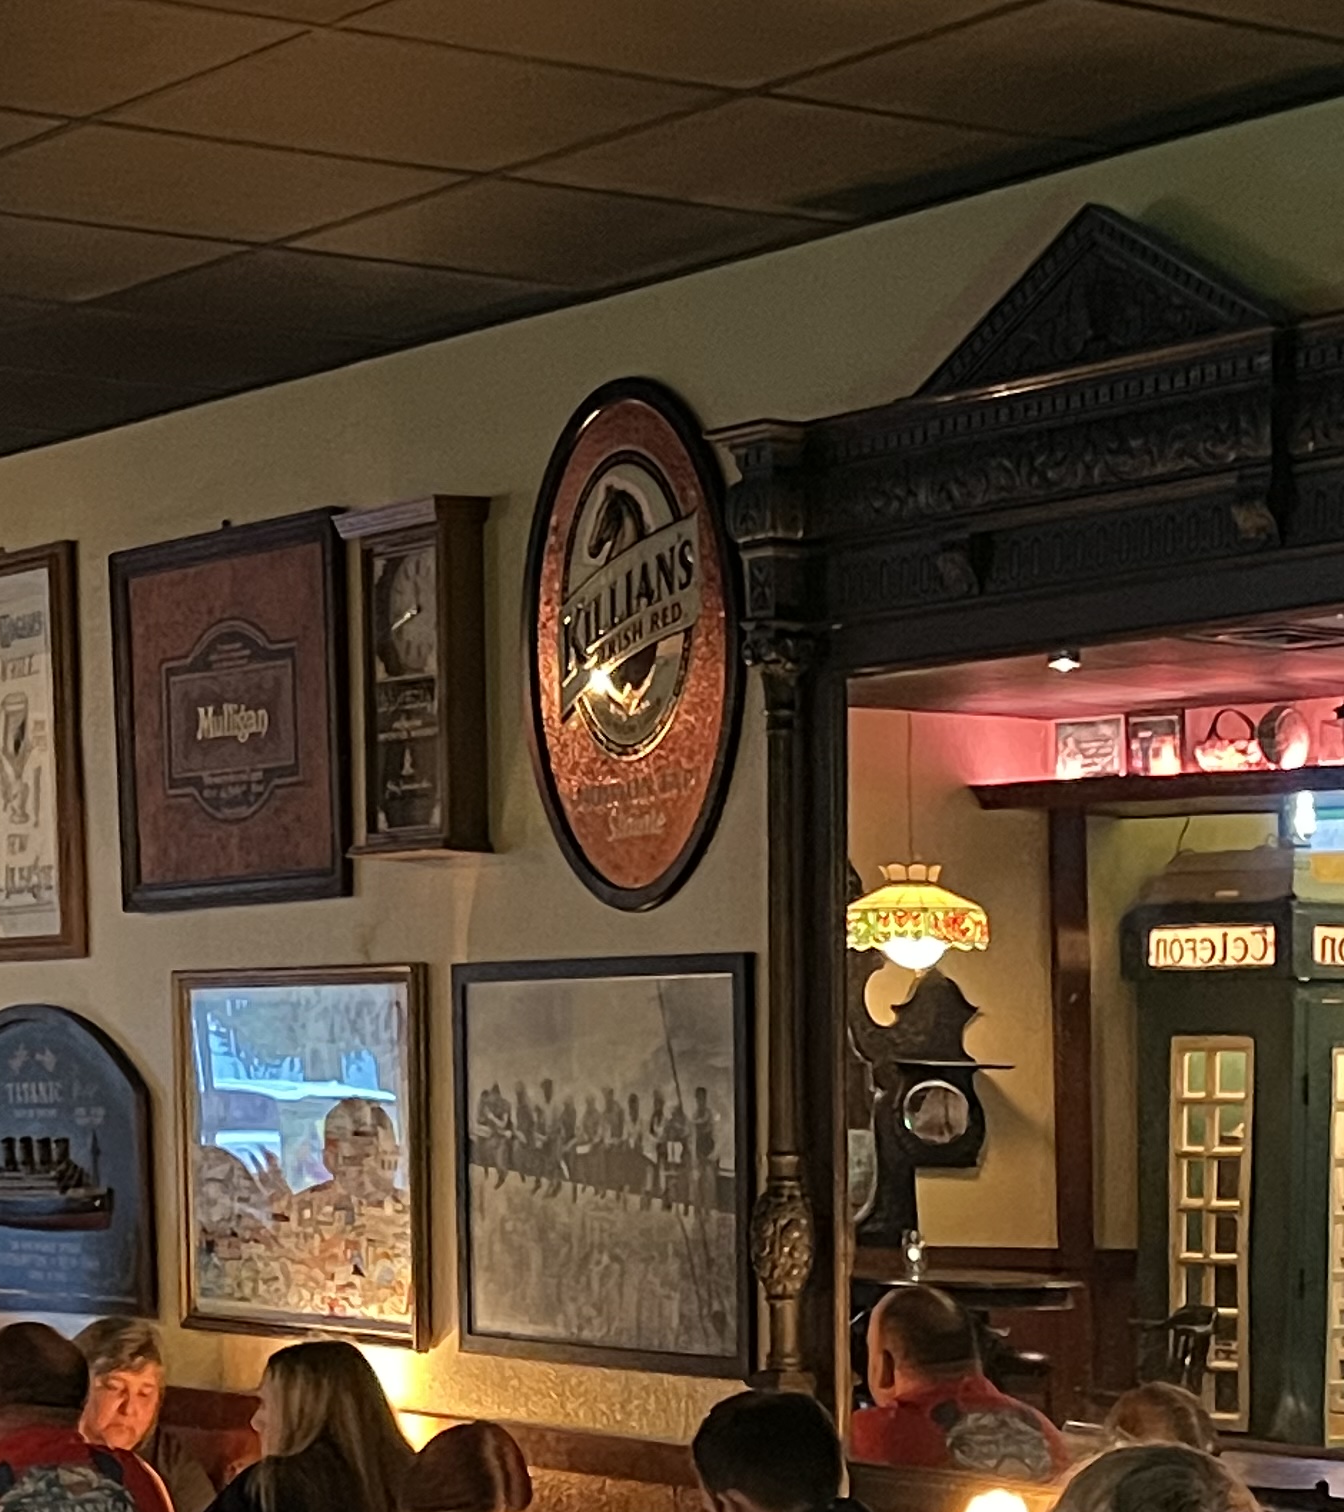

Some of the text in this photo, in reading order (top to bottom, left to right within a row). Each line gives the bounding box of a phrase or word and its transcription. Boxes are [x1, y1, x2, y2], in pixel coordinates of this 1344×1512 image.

[563, 532, 695, 679] KILLIAN'S
[650, 601, 682, 634] RED
[196, 703, 269, 743] Mulligan
